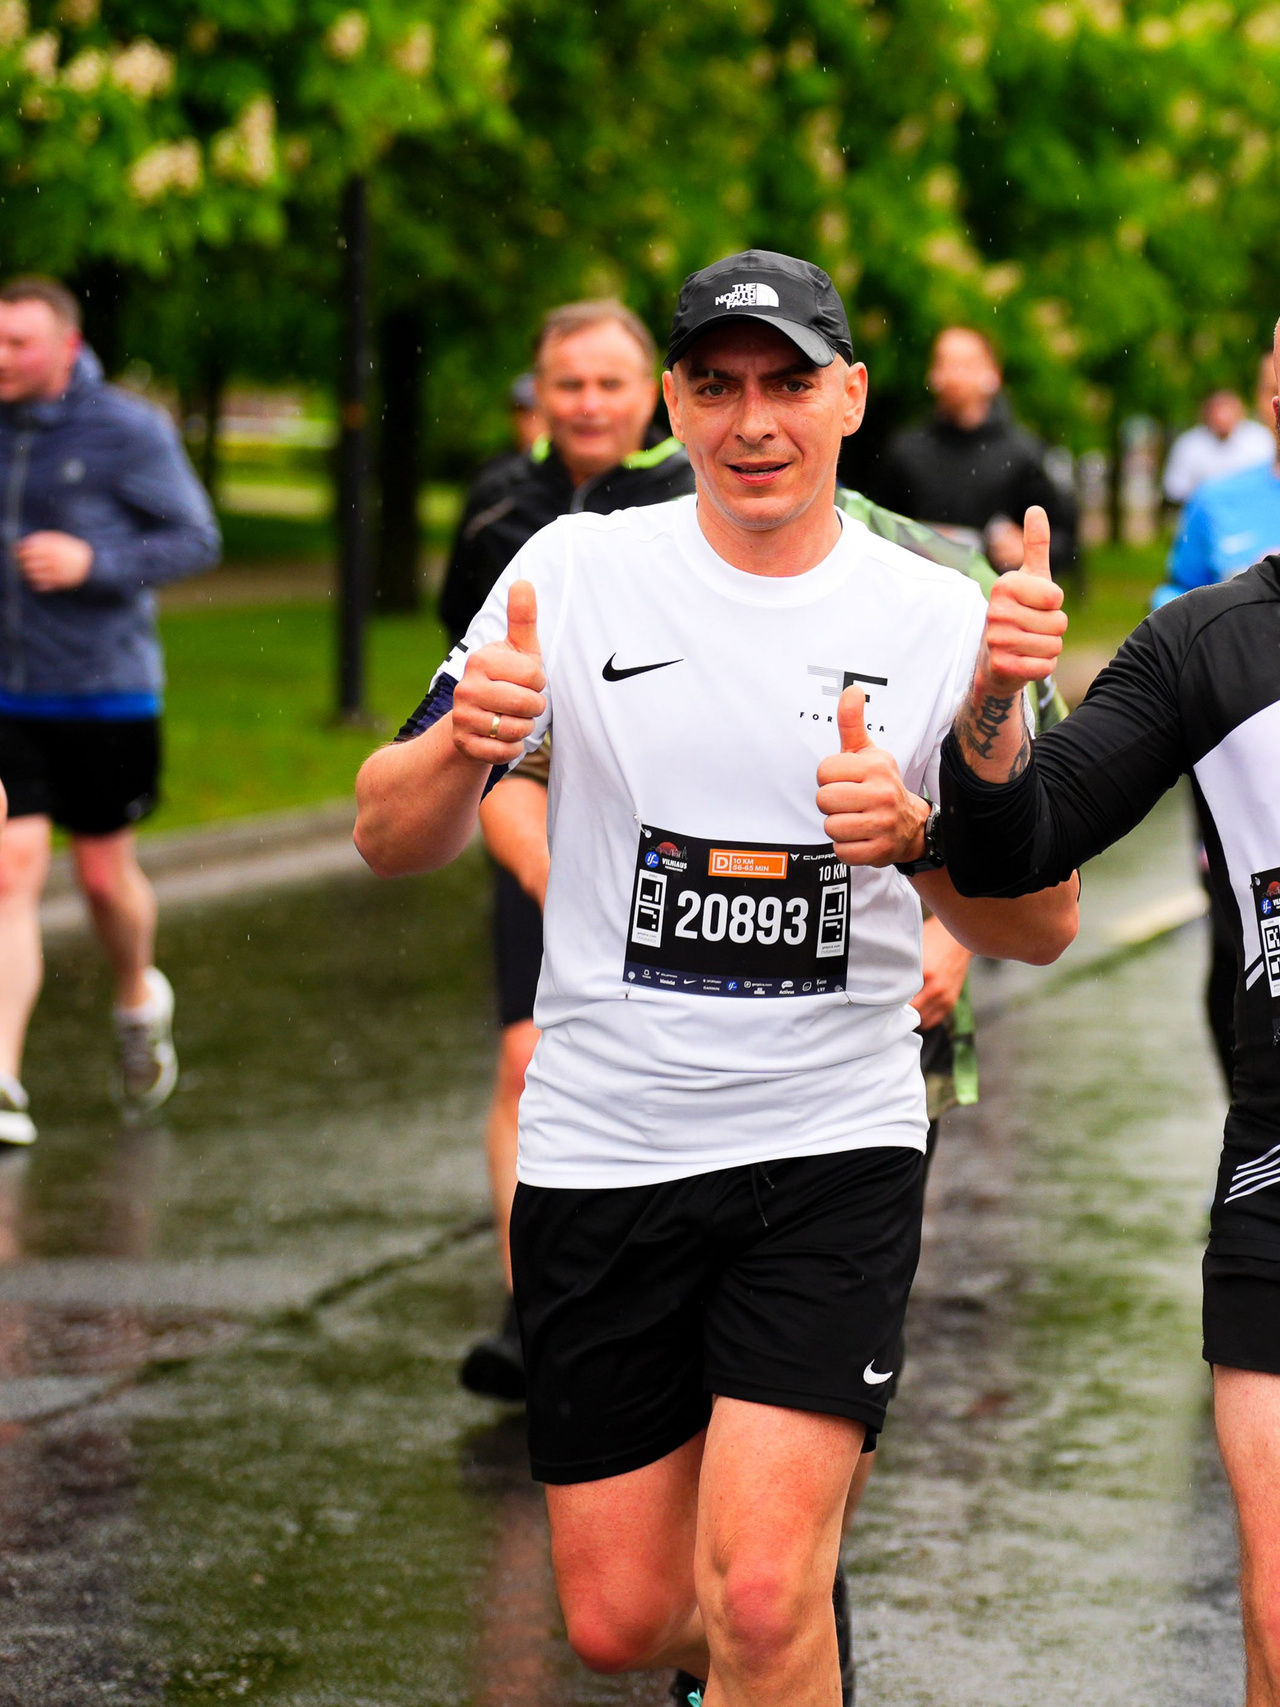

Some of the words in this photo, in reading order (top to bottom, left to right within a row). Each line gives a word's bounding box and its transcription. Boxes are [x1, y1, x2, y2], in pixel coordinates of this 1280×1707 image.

[732, 283, 756, 292] THE
[715, 289, 756, 306] NORTH
[726, 298, 756, 310] FACE
[799, 711, 885, 732] FORCA
[716, 857, 729, 869] D
[819, 865, 831, 882] 10
[833, 863, 848, 881] KM
[674, 890, 809, 946] 20893
